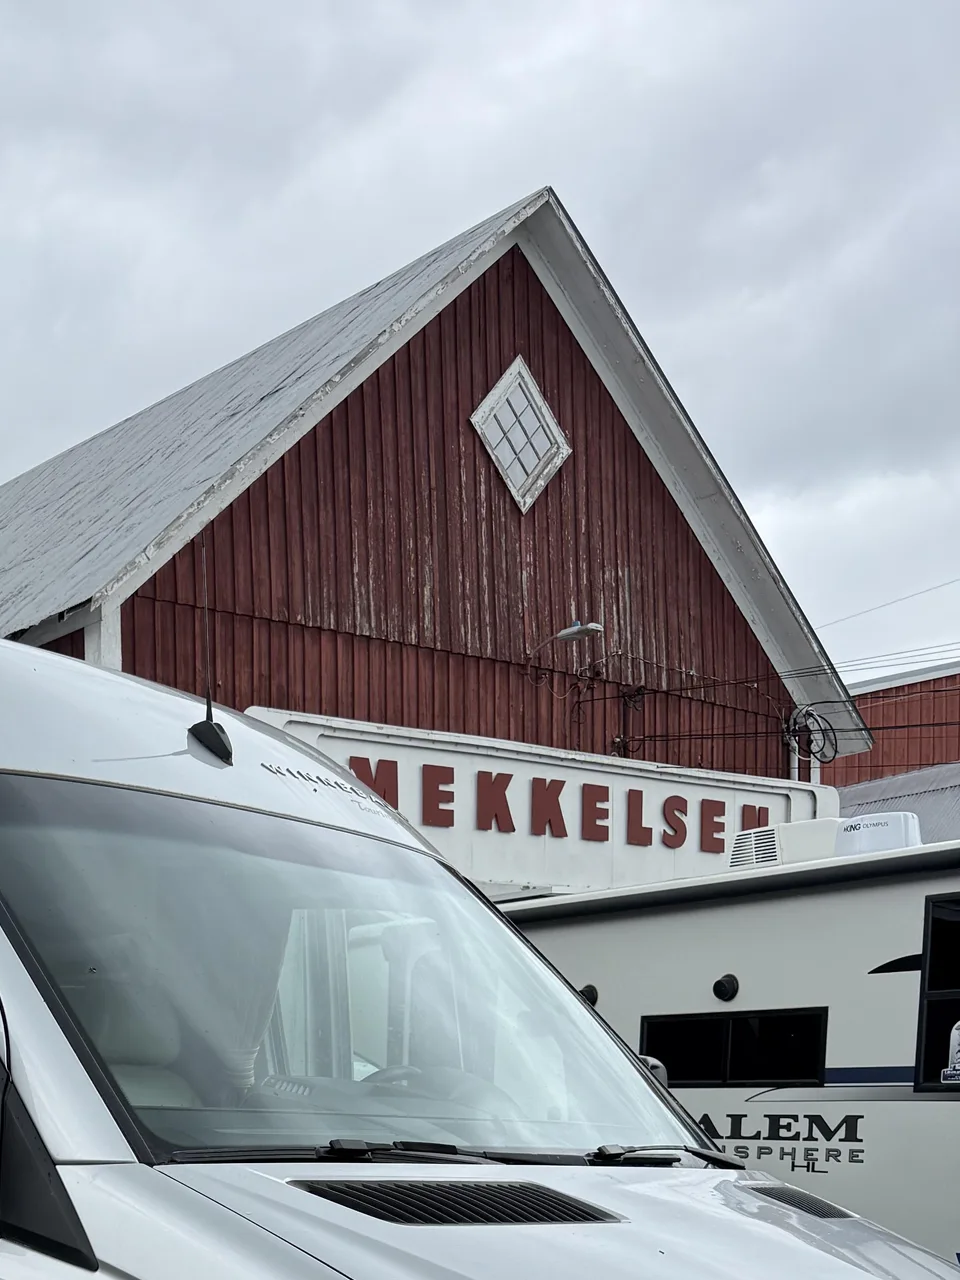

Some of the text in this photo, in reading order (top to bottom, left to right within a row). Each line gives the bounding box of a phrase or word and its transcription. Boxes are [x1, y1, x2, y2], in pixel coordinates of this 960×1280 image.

[260, 763, 409, 823] WINNEB
[862, 821, 889, 829] OLYMPUS
[698, 1113, 865, 1143] ALEM
[721, 1145, 865, 1164] SPHERE
[791, 1160, 829, 1174] HL
